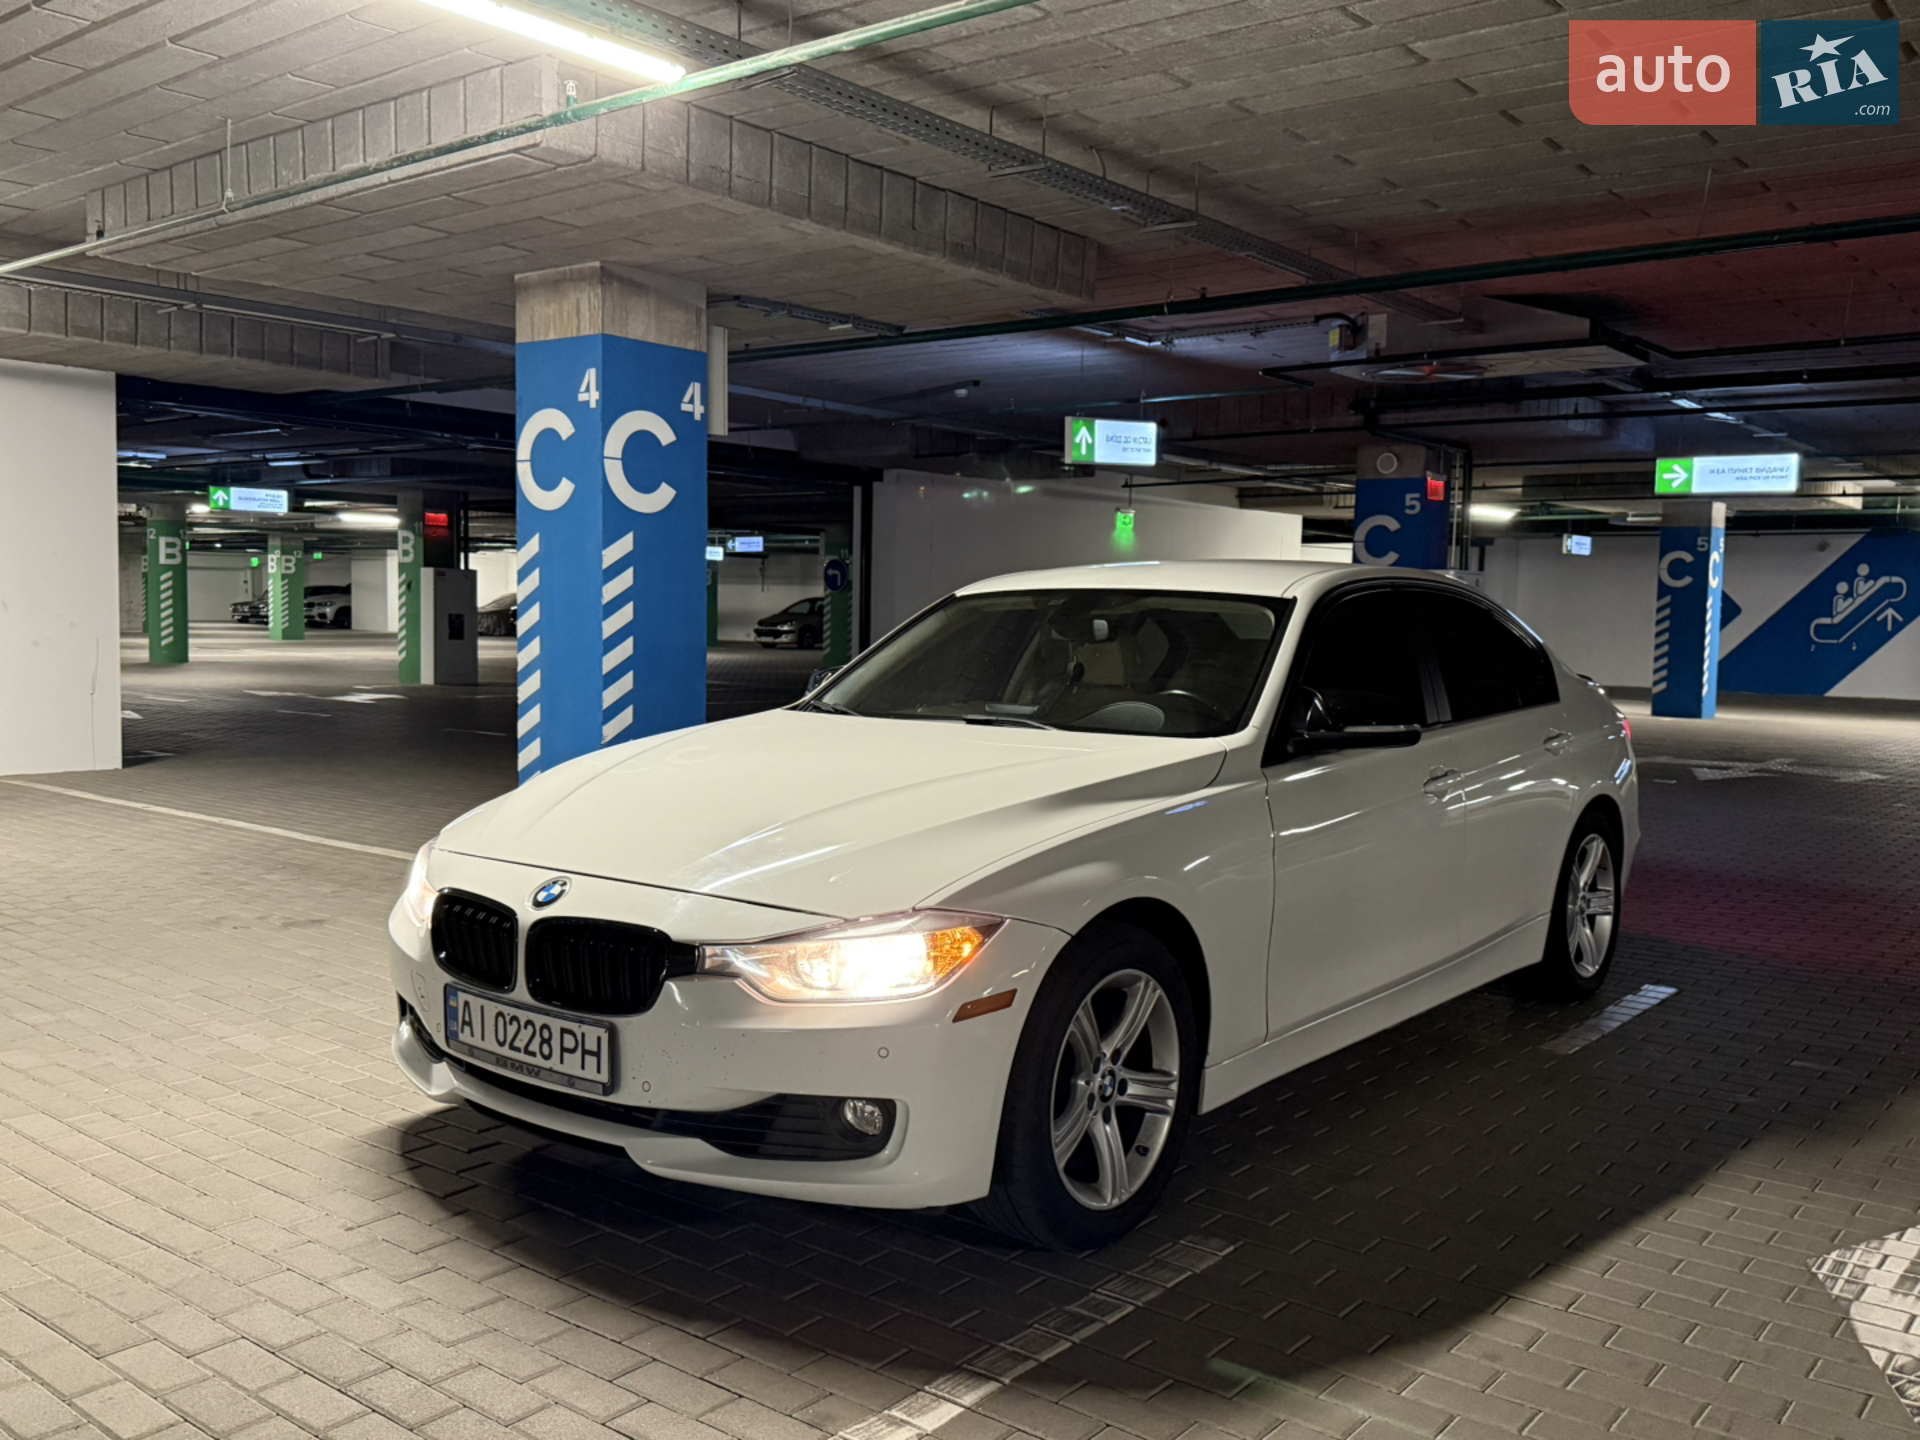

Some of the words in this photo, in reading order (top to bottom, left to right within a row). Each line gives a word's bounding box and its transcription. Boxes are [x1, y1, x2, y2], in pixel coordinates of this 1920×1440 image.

[516, 408, 576, 511] C
[578, 367, 600, 409] 4
[603, 410, 677, 514] C
[681, 382, 705, 421] 4
[398, 530, 415, 563] B
[1353, 514, 1401, 567] C
[1404, 493, 1421, 515] 5
[159, 536, 182, 565] B
[268, 554, 277, 573] B
[282, 554, 297, 574] B
[1659, 550, 1695, 588] C
[1697, 537, 1708, 551] 5
[1709, 551, 1720, 589] C
[461, 1000, 485, 1042] AI
[495, 1010, 553, 1061] 0228
[559, 1027, 602, 1074] PH
[496, 1057, 541, 1077] BMW
